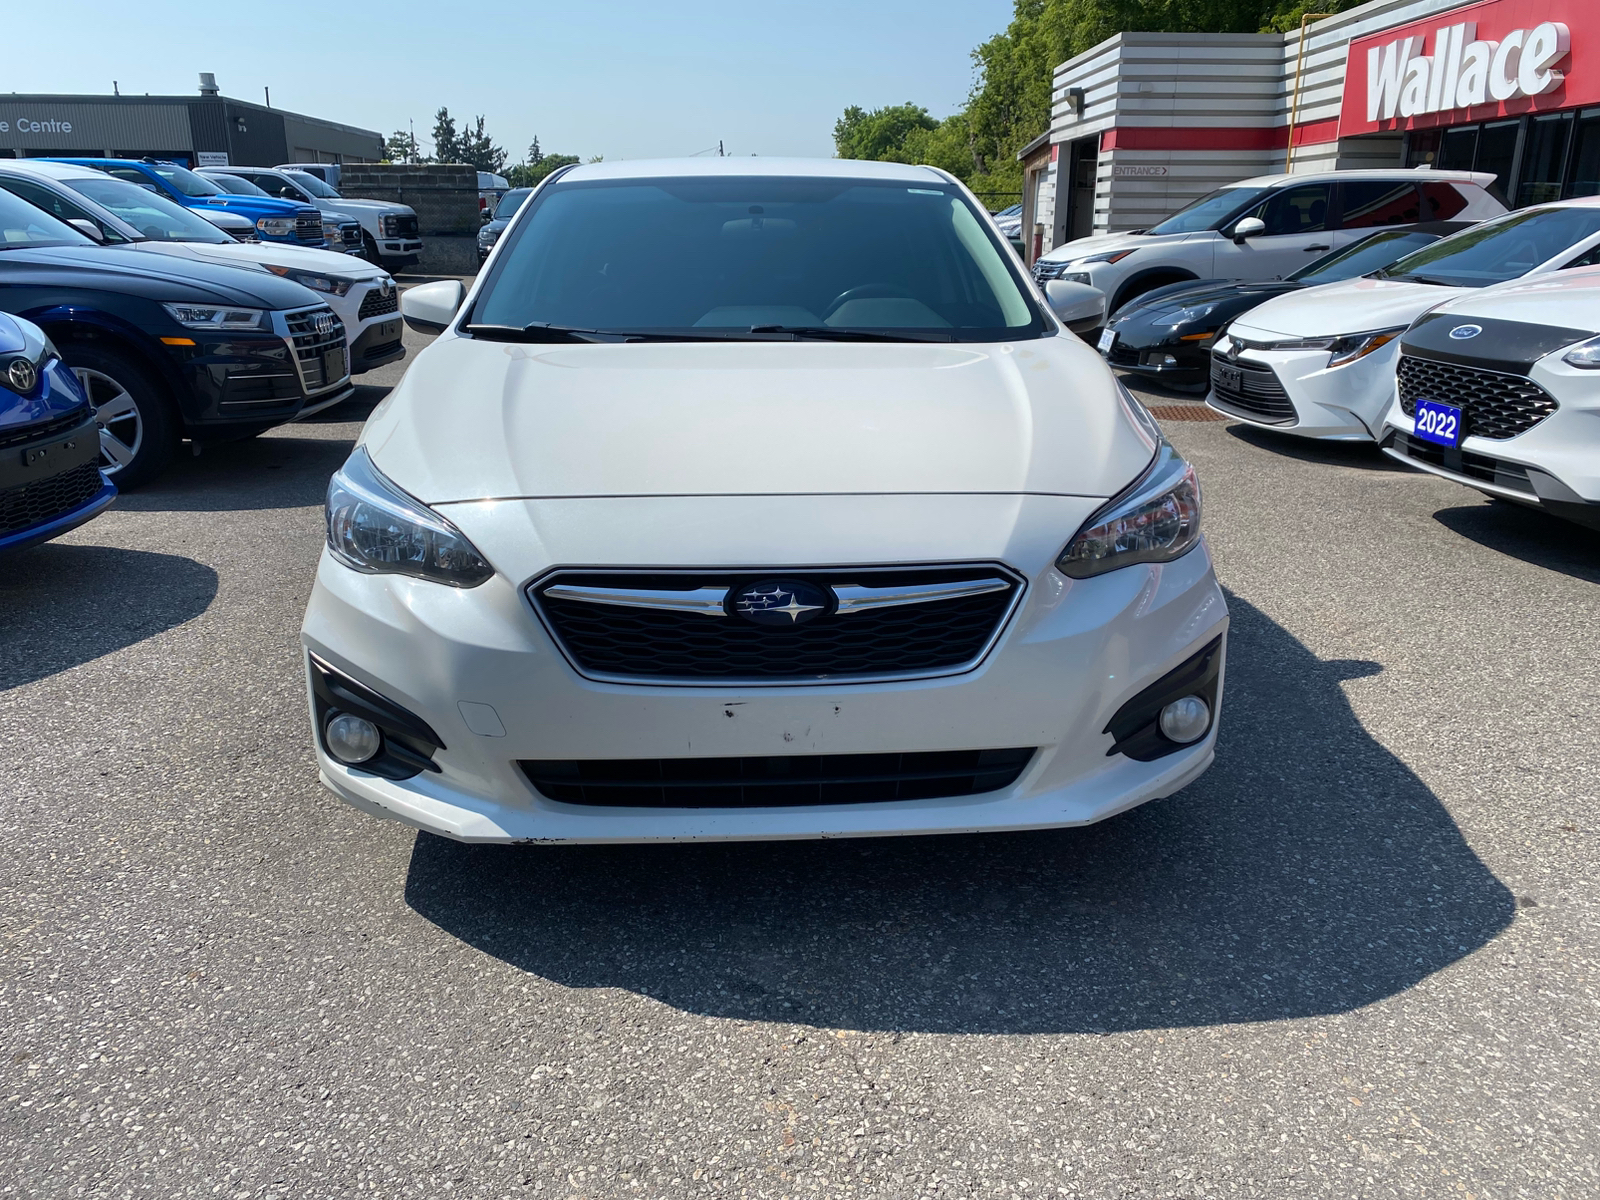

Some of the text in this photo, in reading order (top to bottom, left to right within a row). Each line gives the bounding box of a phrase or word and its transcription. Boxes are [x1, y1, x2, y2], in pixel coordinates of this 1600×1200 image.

[1367, 22, 1571, 122] Wallace
[17, 118, 72, 133] Centre
[1114, 166, 1161, 175] ENTRANCE
[1417, 408, 1457, 439] 2022
